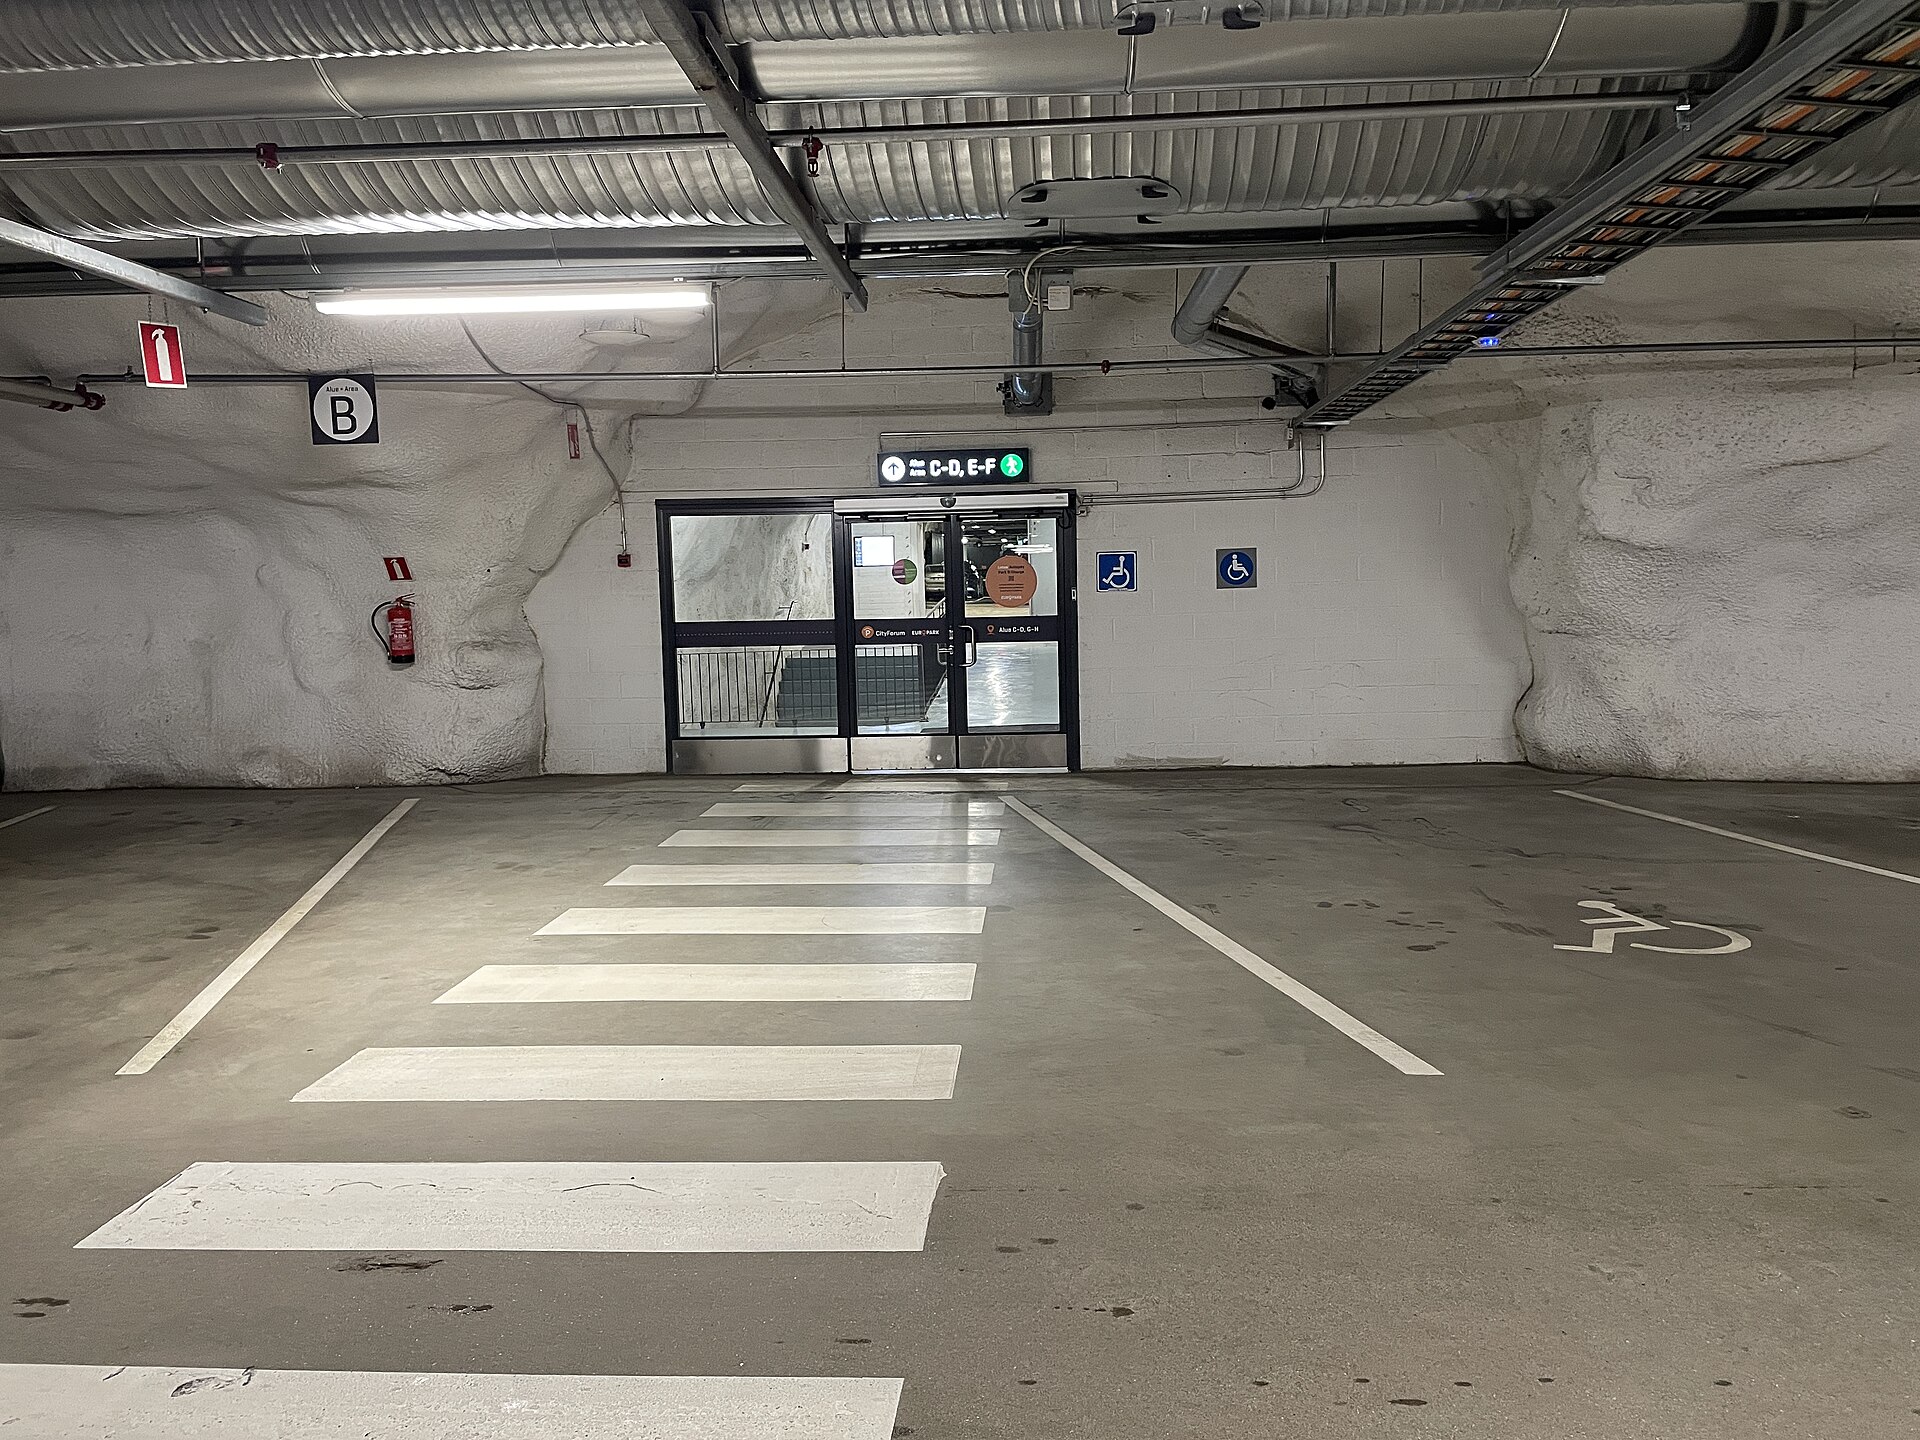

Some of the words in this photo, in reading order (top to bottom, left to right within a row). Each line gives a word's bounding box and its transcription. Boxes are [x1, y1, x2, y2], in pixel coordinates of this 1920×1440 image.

[330, 396, 357, 435] B
[929, 458, 965, 478] C-D,
[967, 457, 997, 476] E-F
